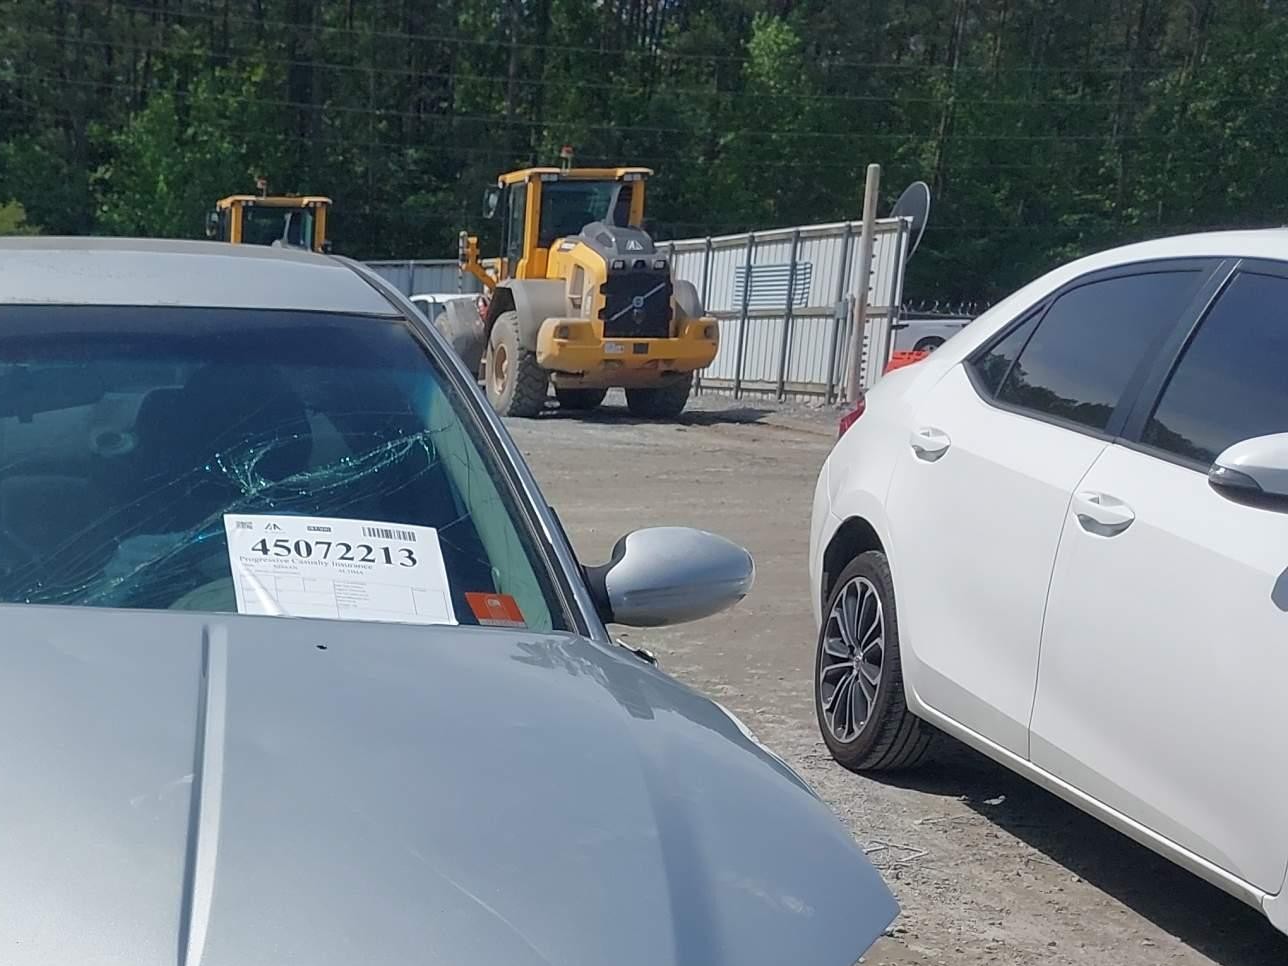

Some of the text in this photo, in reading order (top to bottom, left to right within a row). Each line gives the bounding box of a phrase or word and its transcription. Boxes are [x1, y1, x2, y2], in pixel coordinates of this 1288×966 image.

[239, 555, 373, 570] Progressive Casualty Insurance
[251, 537, 418, 568] 45072213
